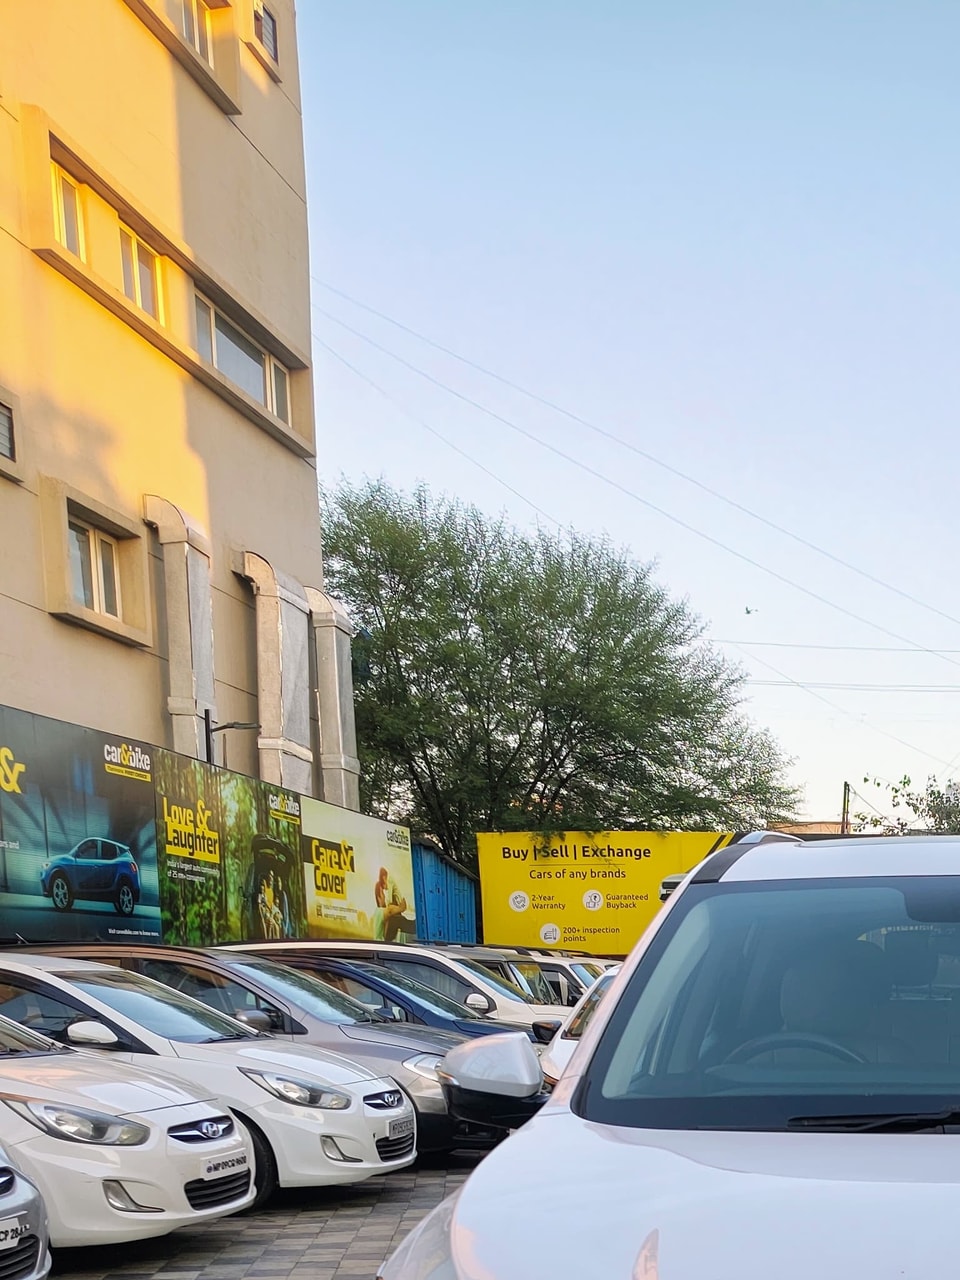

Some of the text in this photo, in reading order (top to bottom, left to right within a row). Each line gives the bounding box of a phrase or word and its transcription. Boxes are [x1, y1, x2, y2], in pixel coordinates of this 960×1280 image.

[104, 743, 151, 771] car&bike
[163, 797, 212, 831] Love &
[166, 822, 218, 856] Laughter
[312, 839, 355, 873] Care &
[502, 847, 529, 861] Buy
[541, 845, 569, 858] Sell
[582, 845, 651, 861] Exchange
[314, 865, 345, 895] Cover
[529, 869, 626, 880] Cars of any brands
[606, 893, 649, 901] Guaranteed
[532, 902, 566, 910] Warranty
[563, 926, 620, 935] 200+ inspection
[563, 935, 586, 943] points
